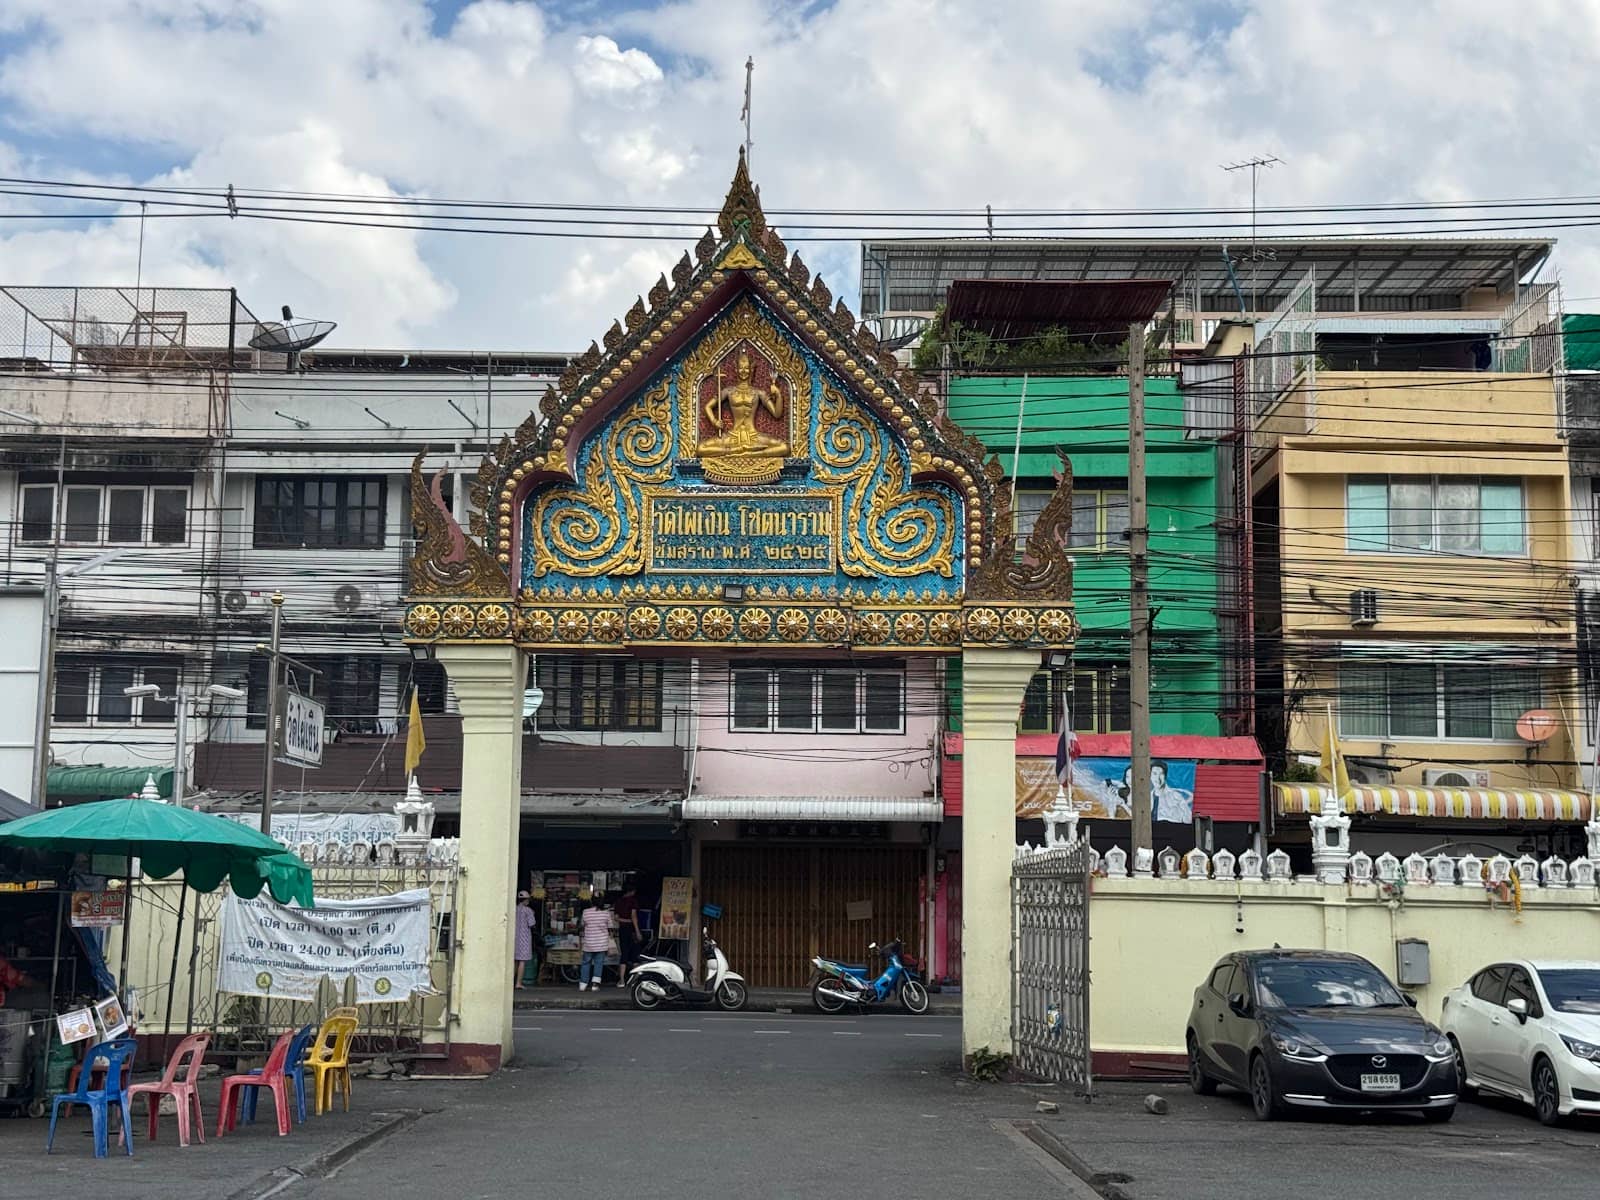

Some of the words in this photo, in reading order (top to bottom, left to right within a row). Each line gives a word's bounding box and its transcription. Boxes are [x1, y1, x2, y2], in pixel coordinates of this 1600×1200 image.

[654, 504, 730, 536] วัดไผ่เงิน
[738, 505, 831, 536] โชตนาราม
[260, 916, 281, 930] เปิด
[286, 920, 311, 933] เวลา
[247, 936, 264, 950] ปิด
[269, 941, 294, 953] เวลา
[299, 943, 331, 957] 24.00
[352, 942, 405, 960] (เที่ยงคืน)
